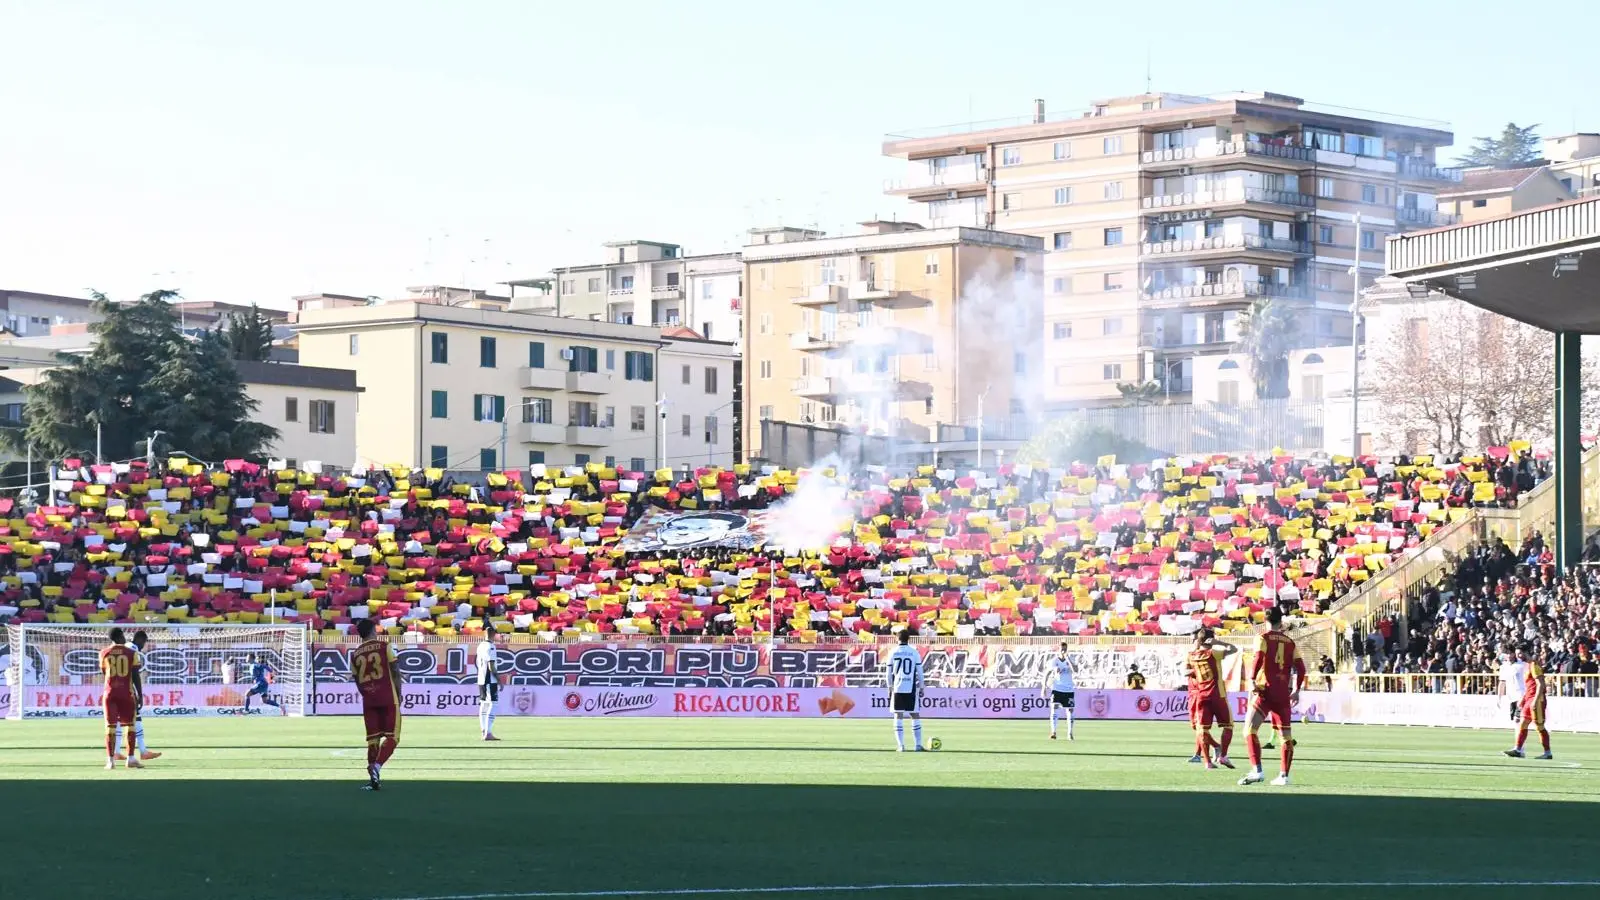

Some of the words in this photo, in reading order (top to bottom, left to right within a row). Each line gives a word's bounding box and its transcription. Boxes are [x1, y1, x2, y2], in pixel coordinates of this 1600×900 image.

[676, 645, 759, 674] PIÙ
[770, 650, 888, 675] BELL
[894, 657, 913, 675] 70
[1275, 642, 1285, 669] 4
[355, 652, 384, 684] 23
[400, 690, 431, 709] gni
[584, 691, 656, 714] Molisana
[673, 692, 800, 713] RIGACUORE
[982, 694, 1016, 712] ogni
[153, 707, 197, 716] GoldBet
